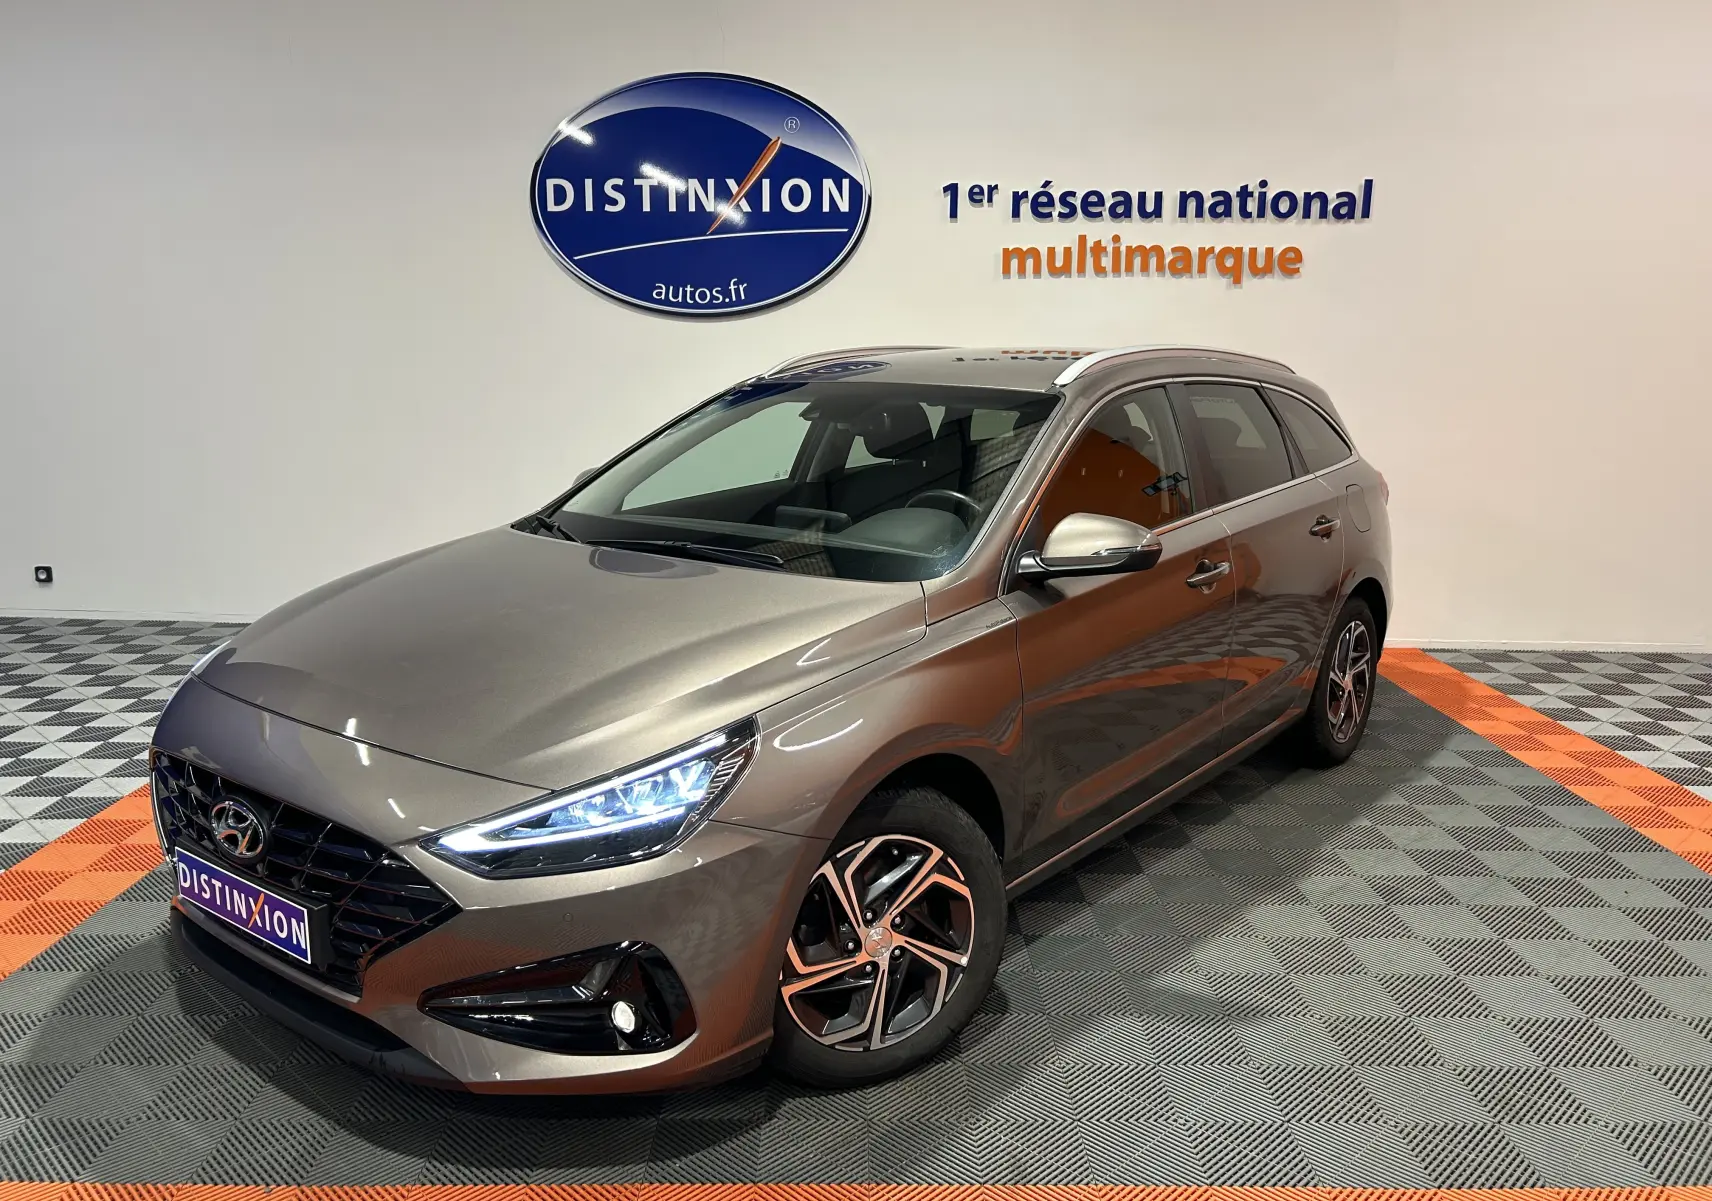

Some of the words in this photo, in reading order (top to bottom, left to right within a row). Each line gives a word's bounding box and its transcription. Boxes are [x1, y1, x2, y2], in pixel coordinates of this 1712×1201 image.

[546, 177, 849, 213] DISTINXION
[942, 182, 999, 219] 1er
[1011, 179, 1164, 219] réseau
[1177, 178, 1374, 220] national
[1001, 233, 1303, 285] multimarque
[652, 278, 748, 304] autos.fr
[178, 861, 306, 950] DISTINXION
